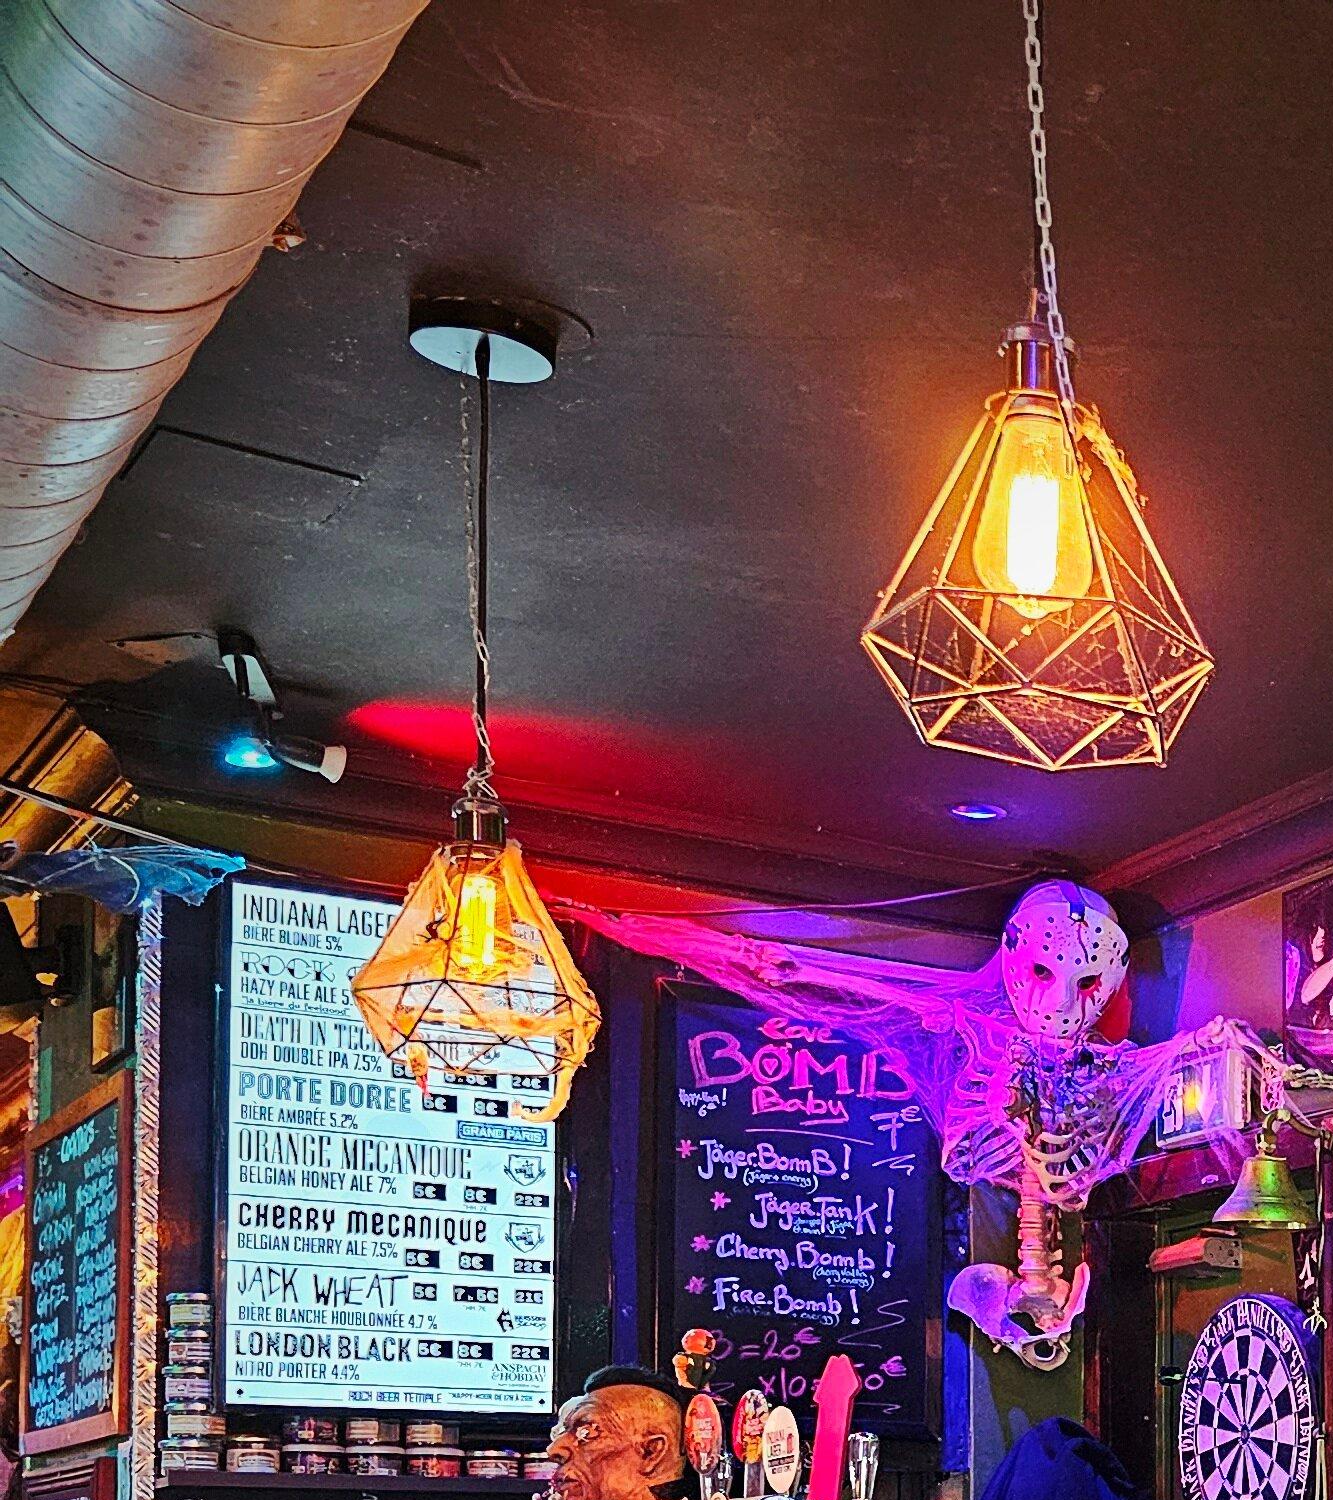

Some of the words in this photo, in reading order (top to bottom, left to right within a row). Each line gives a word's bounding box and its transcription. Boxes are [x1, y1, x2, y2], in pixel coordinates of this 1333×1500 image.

[243, 894, 327, 931] INDIANA
[243, 924, 275, 943] BIÈRE
[279, 929, 322, 948] BLONDE
[326, 935, 342, 951] 5%
[240, 952, 335, 982] ROCK
[241, 976, 275, 997] HAZY
[279, 981, 310, 1001] PALE
[315, 983, 337, 1003] ALE
[241, 1012, 306, 1045] DEATH
[310, 1020, 330, 1047] IN
[274, 1045, 324, 1066] DOUBLE
[329, 1050, 349, 1069] IPA
[353, 1053, 382, 1073] 7.5%
[689, 1031, 916, 1099] BOMB
[239, 1071, 322, 1104] PORTE
[330, 1081, 411, 1113] DOREE
[752, 1087, 847, 1125] Baby
[240, 1102, 274, 1121] BIÈRE
[278, 1107, 326, 1127] AMBRÉE
[329, 1112, 358, 1129] 5.2%
[463, 1125, 504, 1138] GRAND
[507, 1128, 543, 1142] PARIS
[239, 1128, 332, 1169] ORANGE
[341, 1135, 471, 1179] MECANIQUE
[239, 1166, 296, 1188] BELGIAN
[302, 1170, 346, 1192] HONEY
[350, 1174, 374, 1193] ALE
[378, 1176, 397, 1195] 7%
[238, 1232, 289, 1252] BELGIAN
[294, 1237, 342, 1256] CHERRY
[346, 1240, 367, 1257] ALE
[371, 1241, 398, 1259] 7.5%
[238, 1265, 298, 1303] JACK
[313, 1274, 408, 1308] WHEAT
[239, 1302, 272, 1322] BIÈRE
[276, 1306, 328, 1325] BLANCHE
[331, 1309, 404, 1329] HOUBLONNÉE
[236, 1329, 331, 1360] LONDON
[338, 1336, 411, 1362] BLACK
[235, 1361, 273, 1379] NITRO
[278, 1362, 326, 1380] PORTER
[331, 1364, 359, 1381] 4.4%
[493, 1364, 546, 1374] ANSPACH
